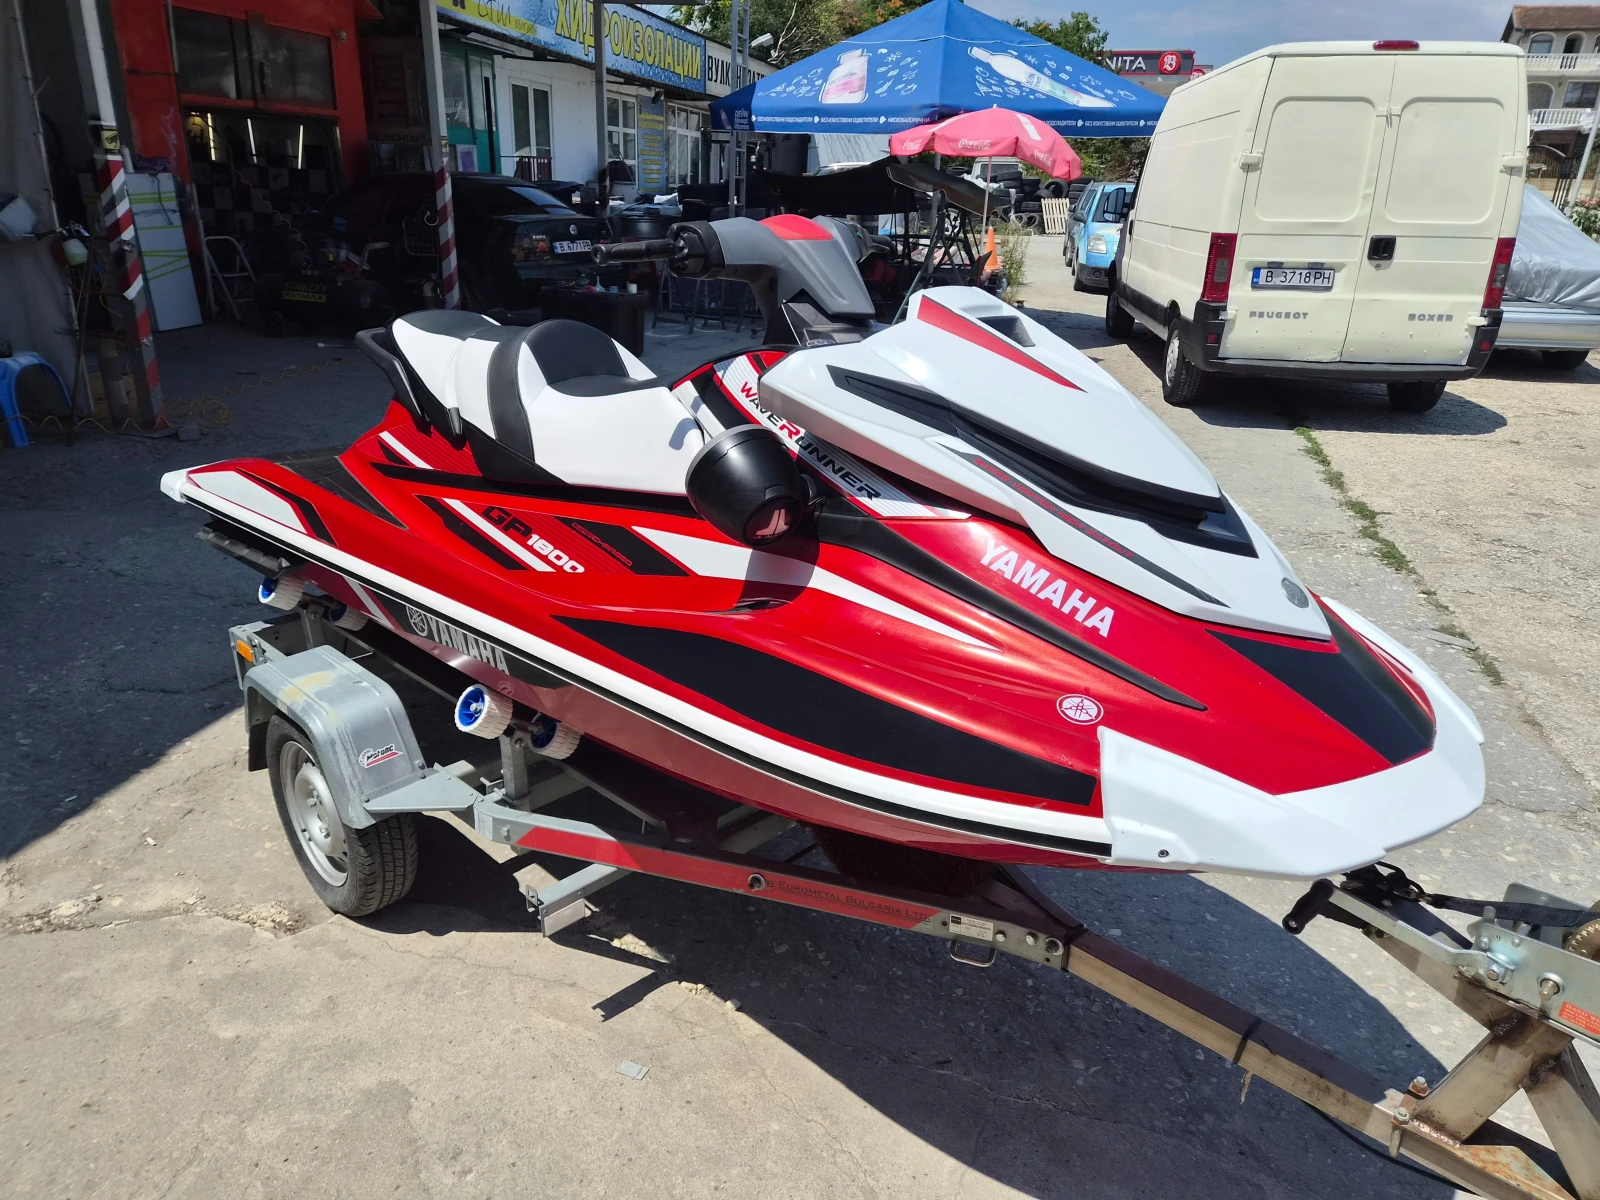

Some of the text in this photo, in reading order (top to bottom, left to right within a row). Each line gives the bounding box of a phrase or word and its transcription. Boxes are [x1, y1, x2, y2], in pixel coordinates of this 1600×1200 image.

[1249, 311, 1309, 320] PEUGEOT
[1408, 313, 1454, 322] BOXER
[973, 457, 1012, 482] SUPER
[1011, 481, 1056, 511] VORTEX
[1057, 510, 1085, 530] HIGH
[980, 539, 1115, 638] YAMAHA
[427, 614, 510, 676] YAMAHA
